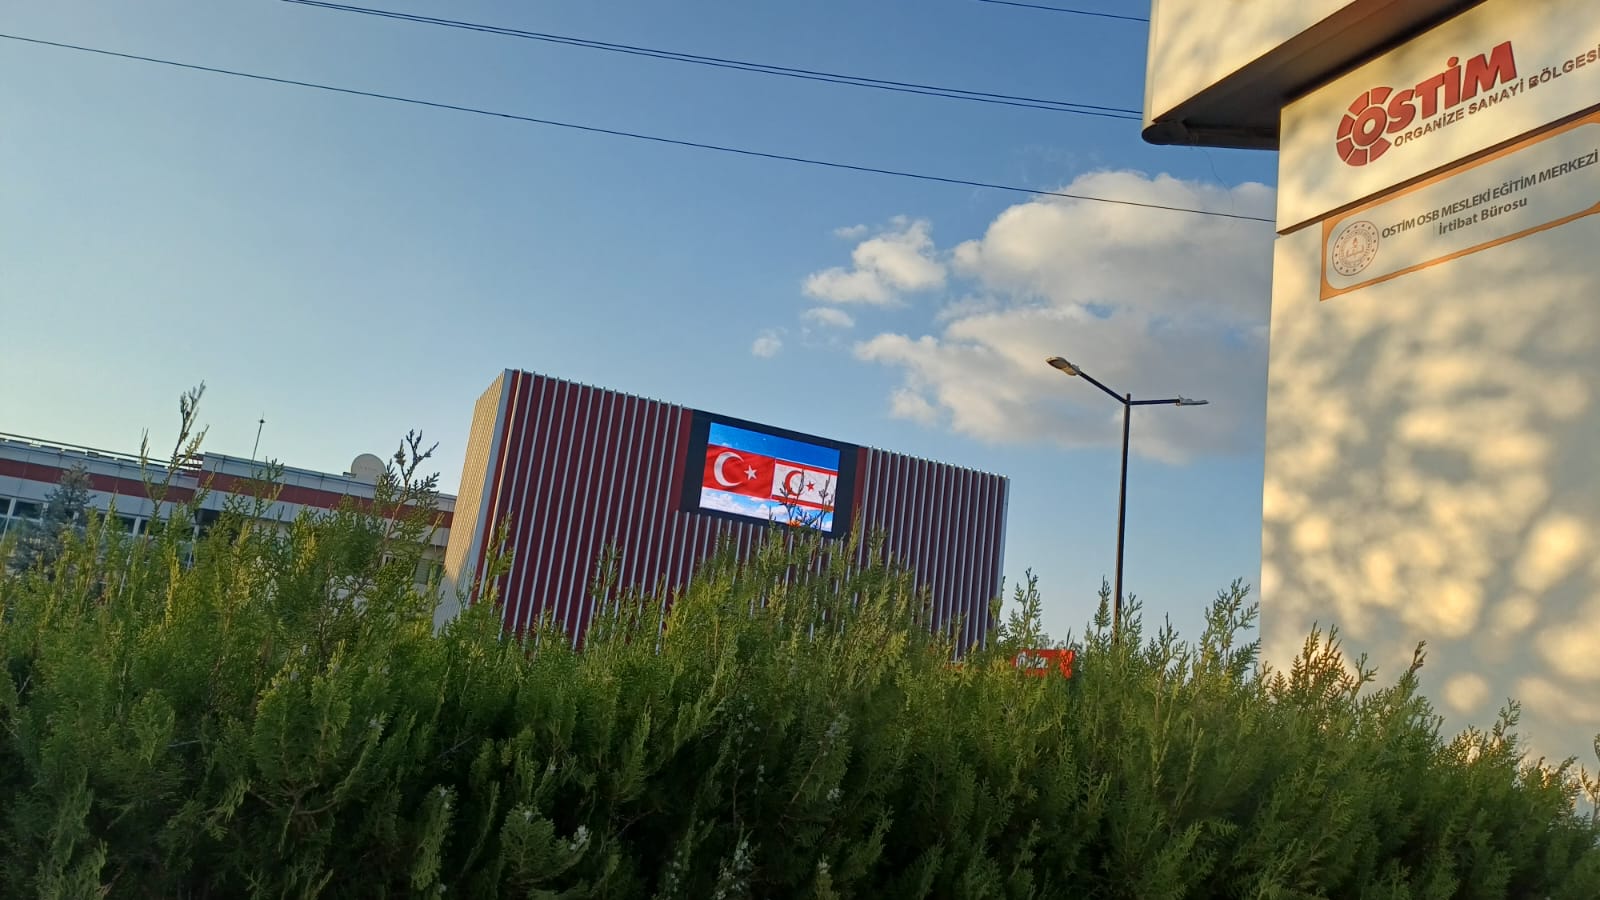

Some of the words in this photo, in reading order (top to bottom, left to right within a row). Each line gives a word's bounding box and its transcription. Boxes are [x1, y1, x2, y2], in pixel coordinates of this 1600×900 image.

[1394, 107, 1465, 147] ORGANİZE
[1468, 78, 1524, 115] SANAYİ
[1382, 217, 1415, 239] OSTİM
[1416, 209, 1440, 226] OSB
[1441, 188, 1491, 218] MESLEKİ
[1492, 174, 1536, 200] EĞİTİM
[1538, 148, 1599, 183] MERKEZİ
[1439, 212, 1478, 236] İrtibat
[1481, 197, 1527, 222] Bürosu
